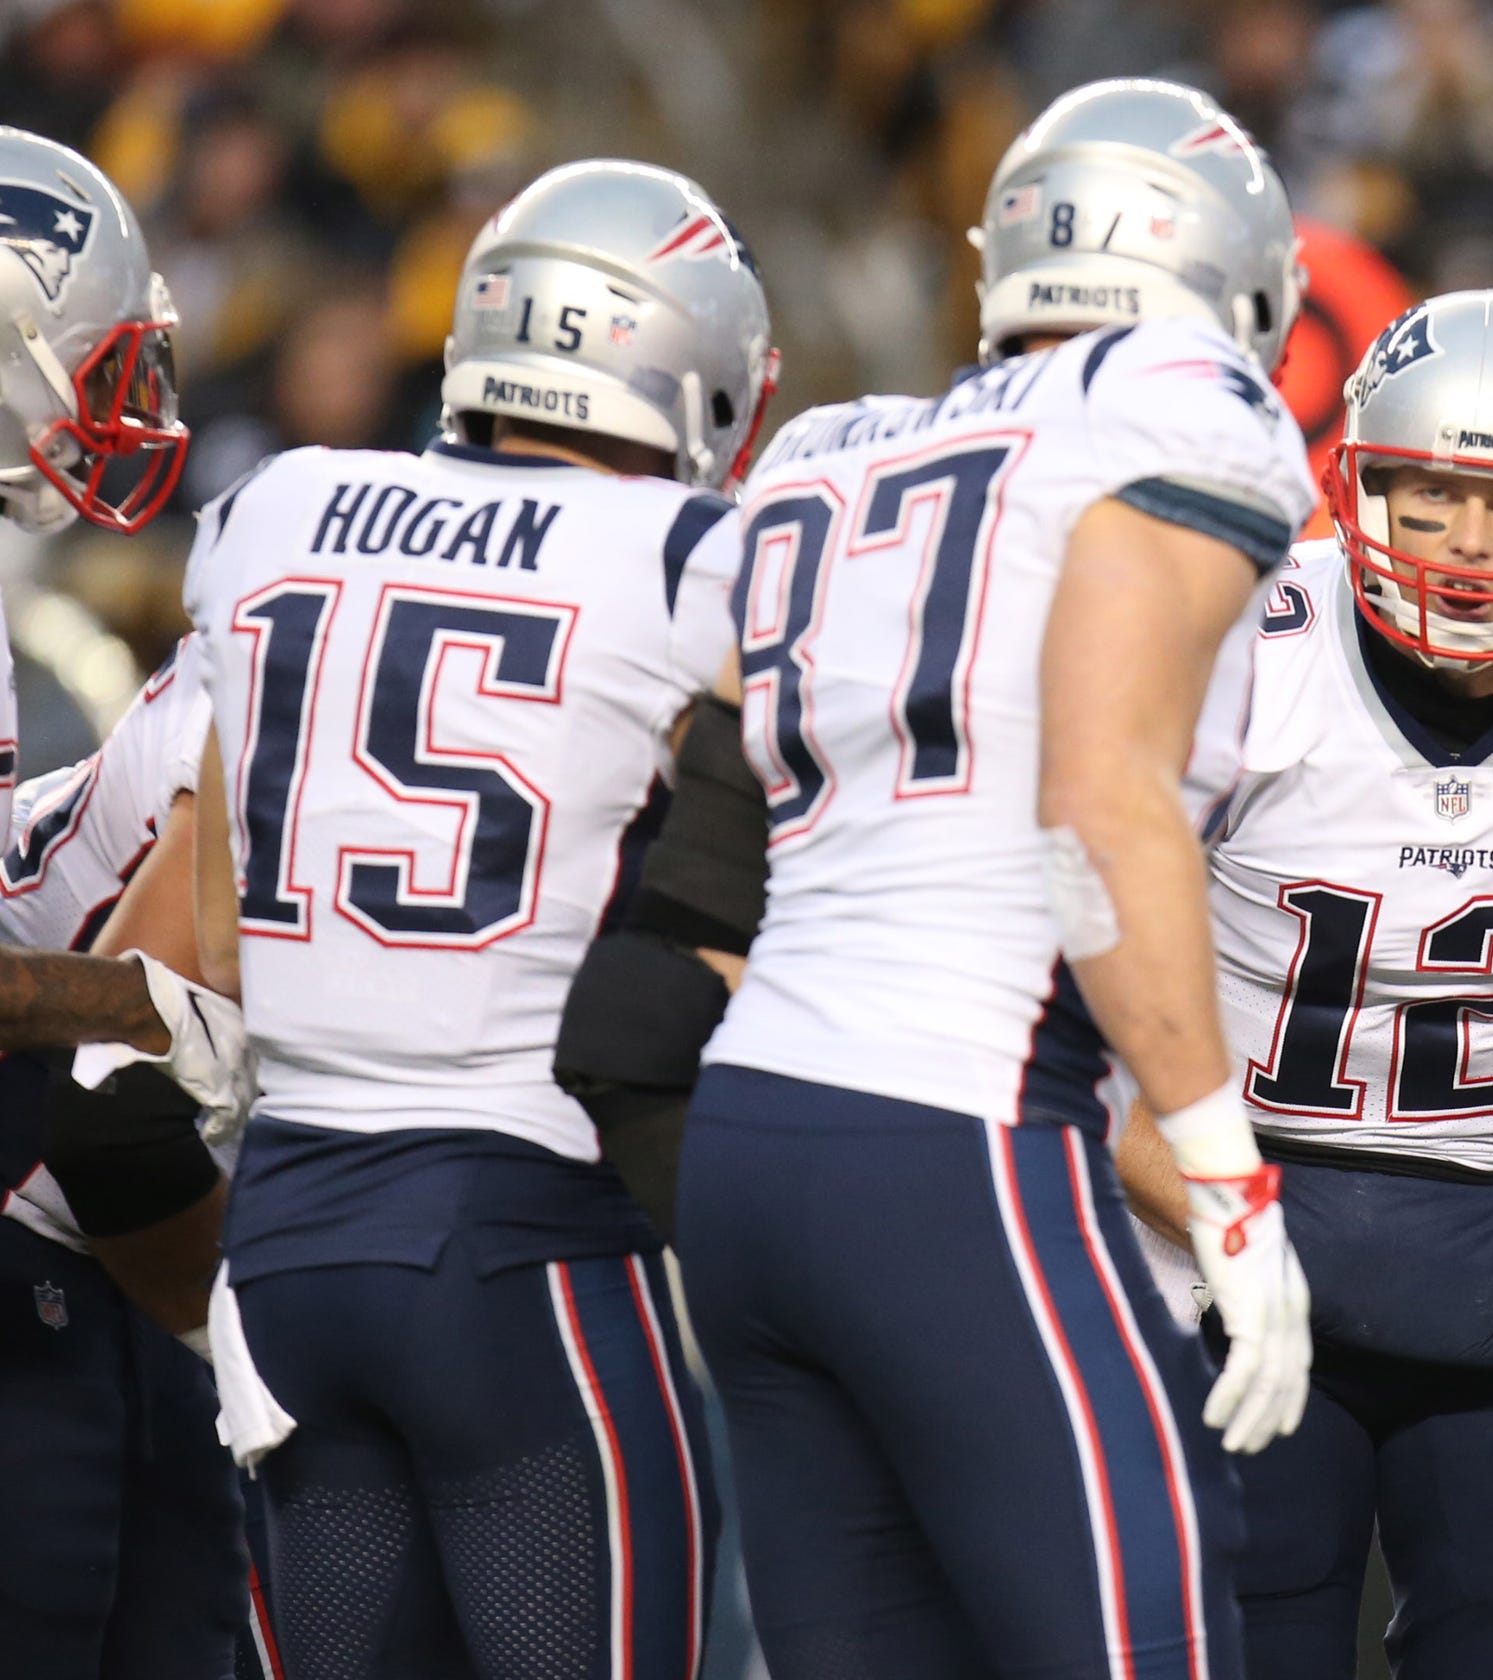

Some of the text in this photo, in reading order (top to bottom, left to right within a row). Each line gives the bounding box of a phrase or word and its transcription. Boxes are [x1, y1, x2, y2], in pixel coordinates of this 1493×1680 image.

[516, 297, 587, 352] 15
[1029, 283, 1139, 314] PATRIOTS
[483, 376, 591, 420] PATRIOTS
[310, 484, 562, 571] HOGAN
[730, 429, 1034, 848] 87
[231, 576, 579, 950] 15
